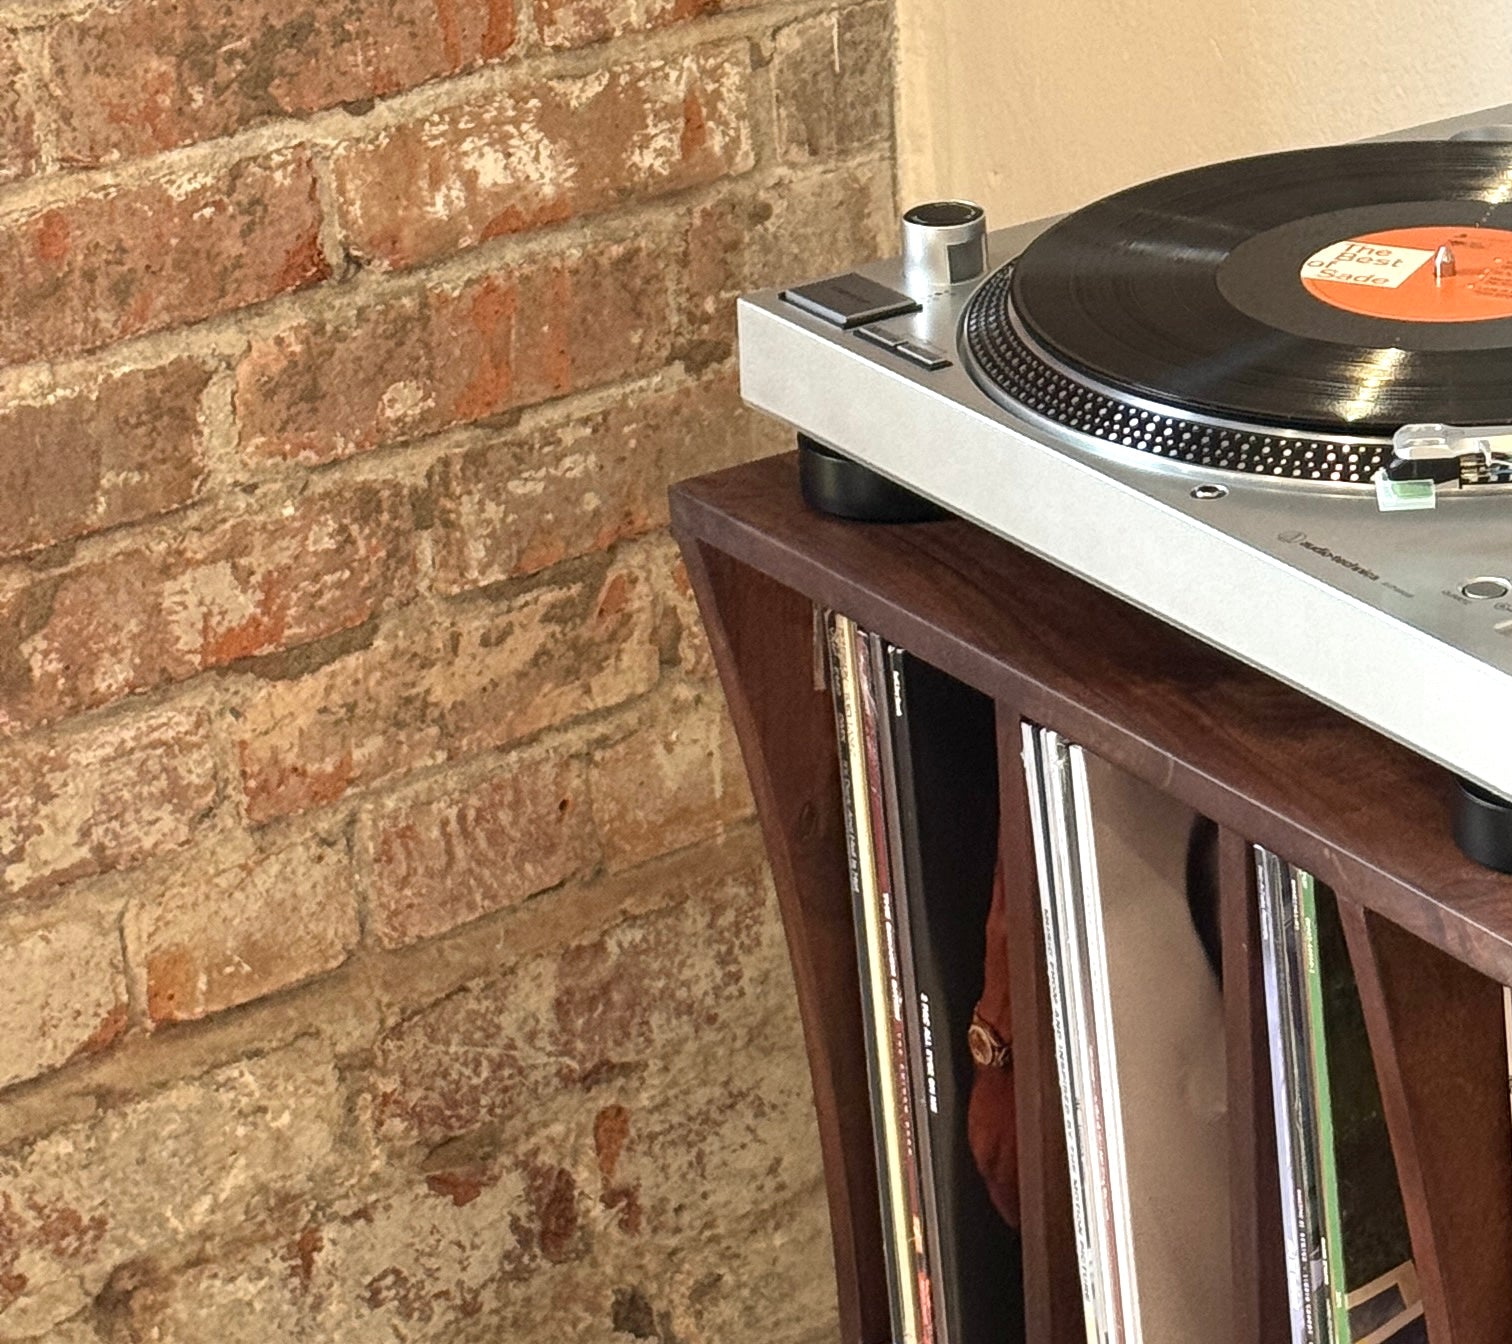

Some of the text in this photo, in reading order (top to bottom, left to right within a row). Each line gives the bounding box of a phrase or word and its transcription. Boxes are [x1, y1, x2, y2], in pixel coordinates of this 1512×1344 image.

[1343, 244, 1392, 256] The
[1334, 252, 1404, 268] Best
[1317, 268, 1390, 285] Sade
